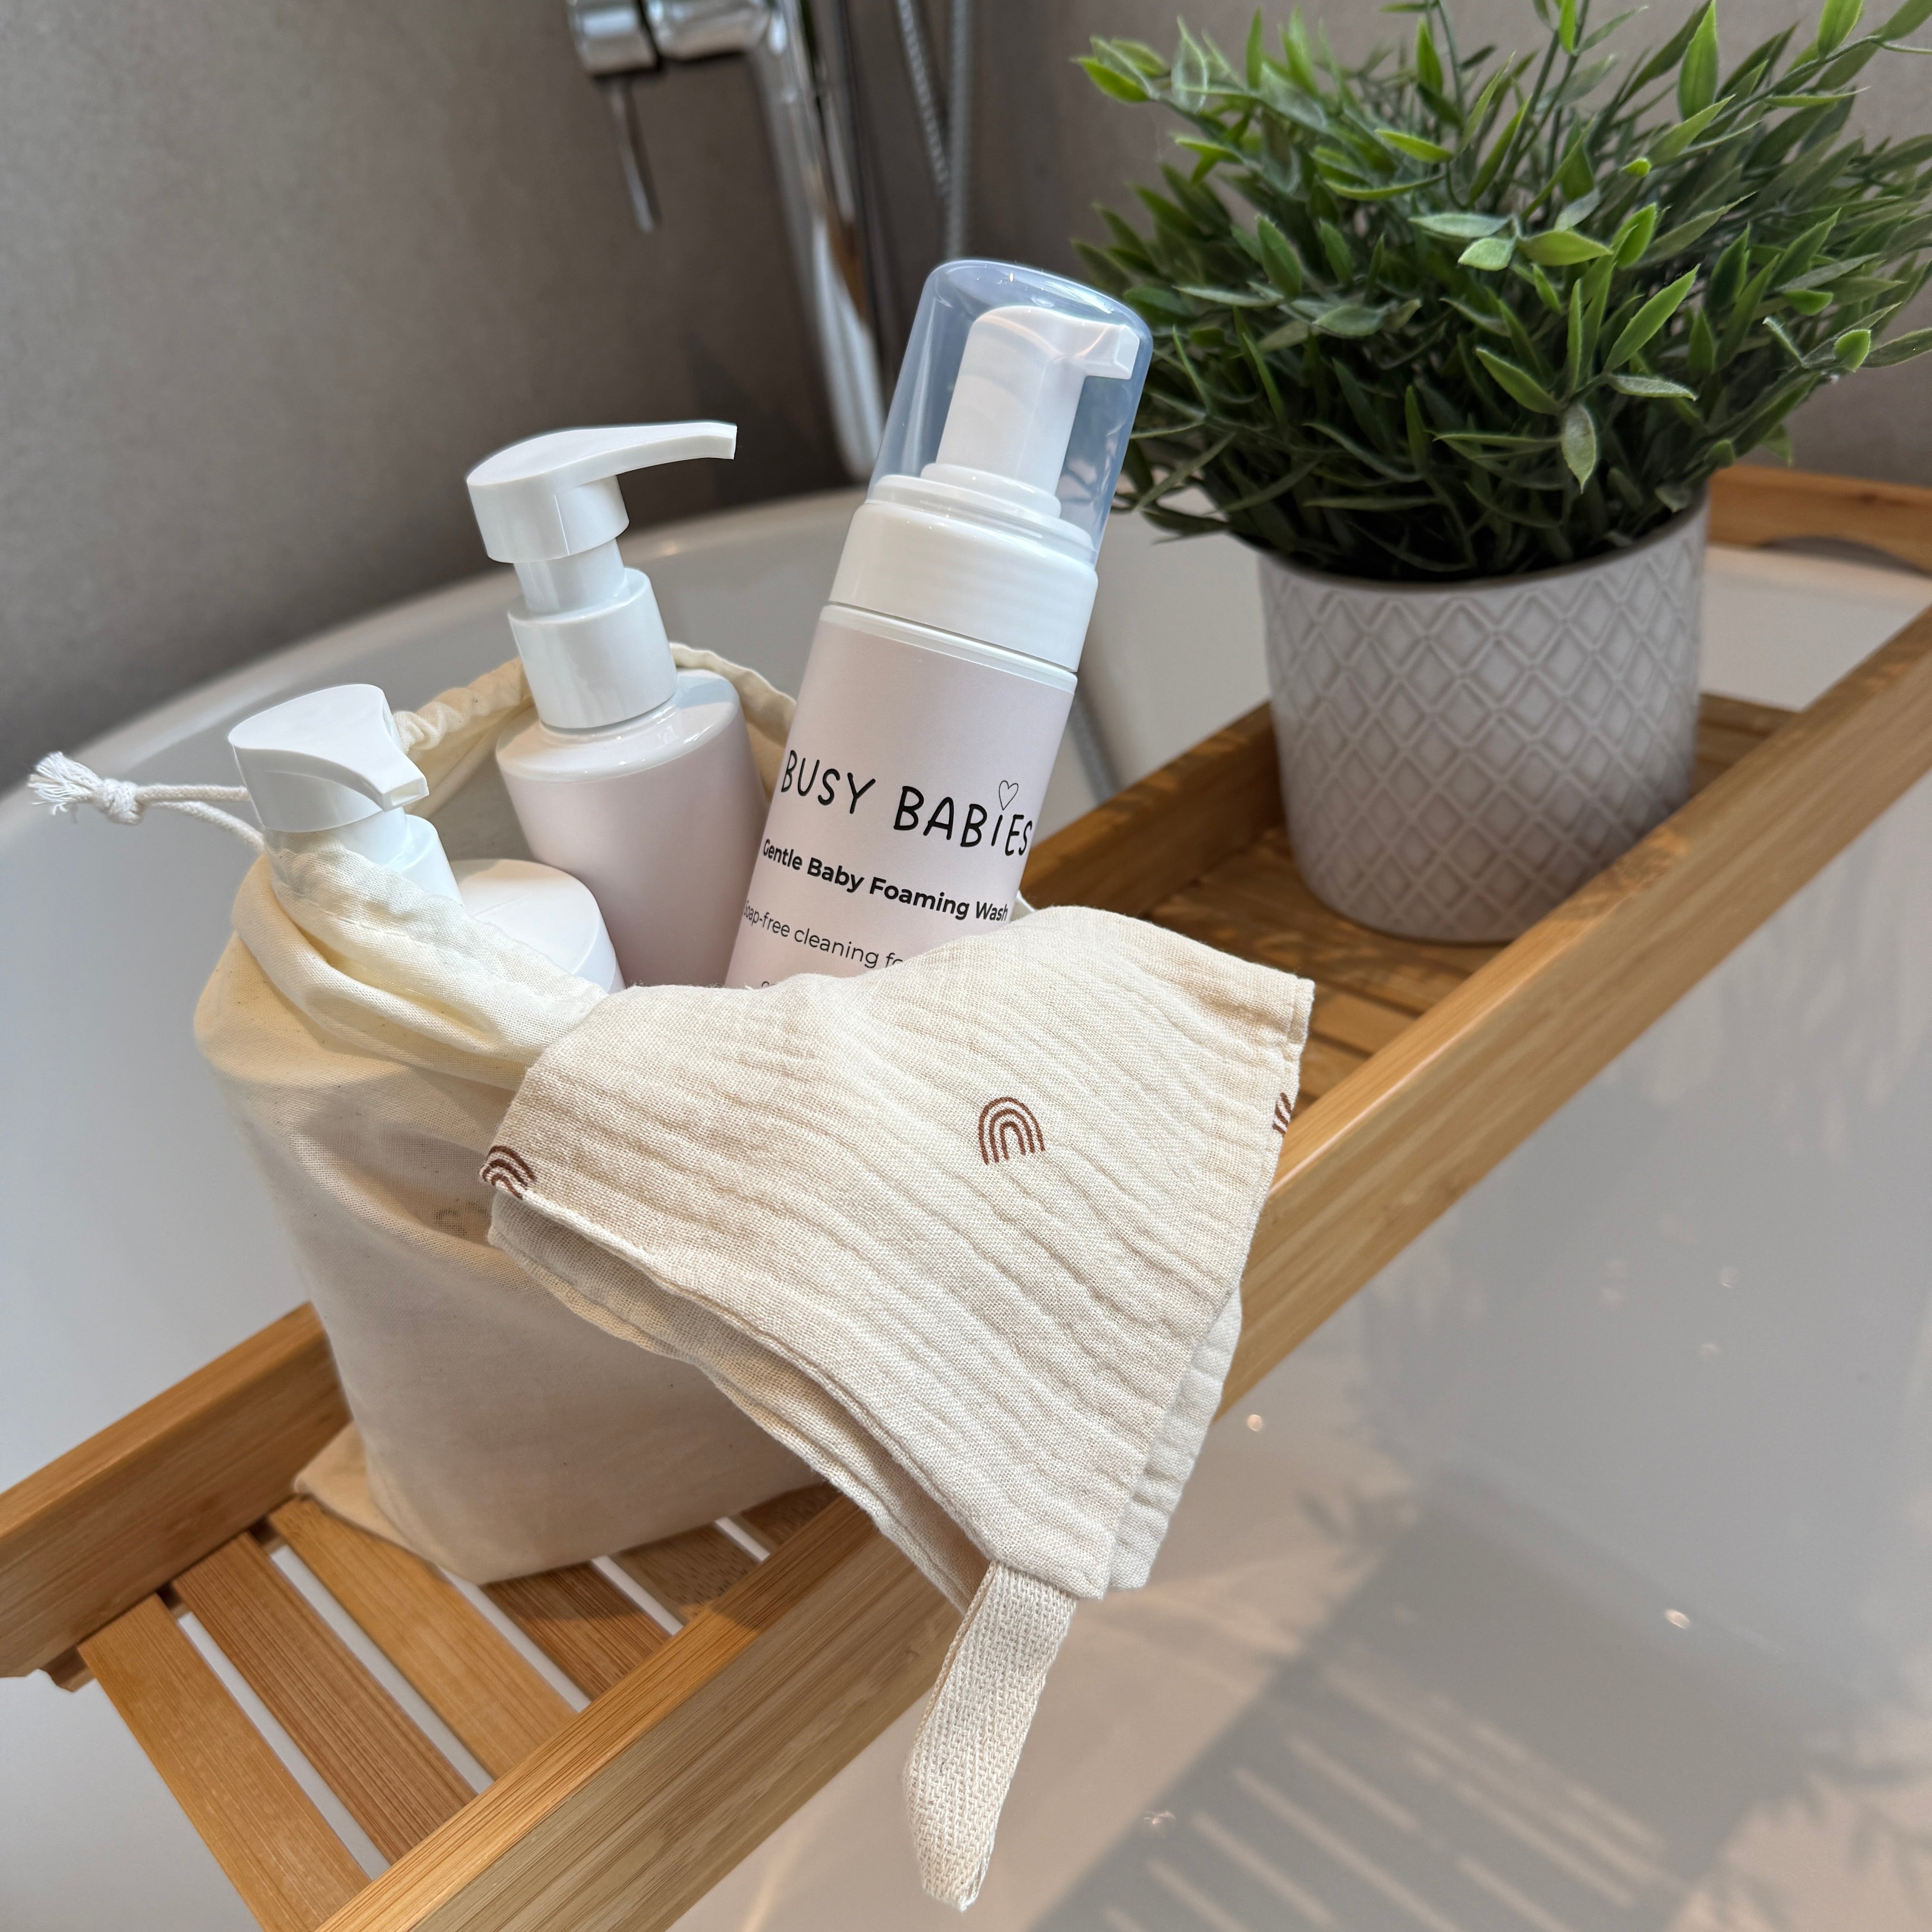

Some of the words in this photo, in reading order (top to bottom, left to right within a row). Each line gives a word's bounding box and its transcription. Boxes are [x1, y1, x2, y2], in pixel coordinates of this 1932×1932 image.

[781, 750, 876, 814] BUSY
[893, 785, 1033, 856] BABIES
[763, 839, 803, 870] Gentle
[807, 857, 865, 893] Baby
[869, 877, 970, 920] Foaming
[976, 901, 1008, 921] Wash
[794, 928, 879, 968] cleaning
